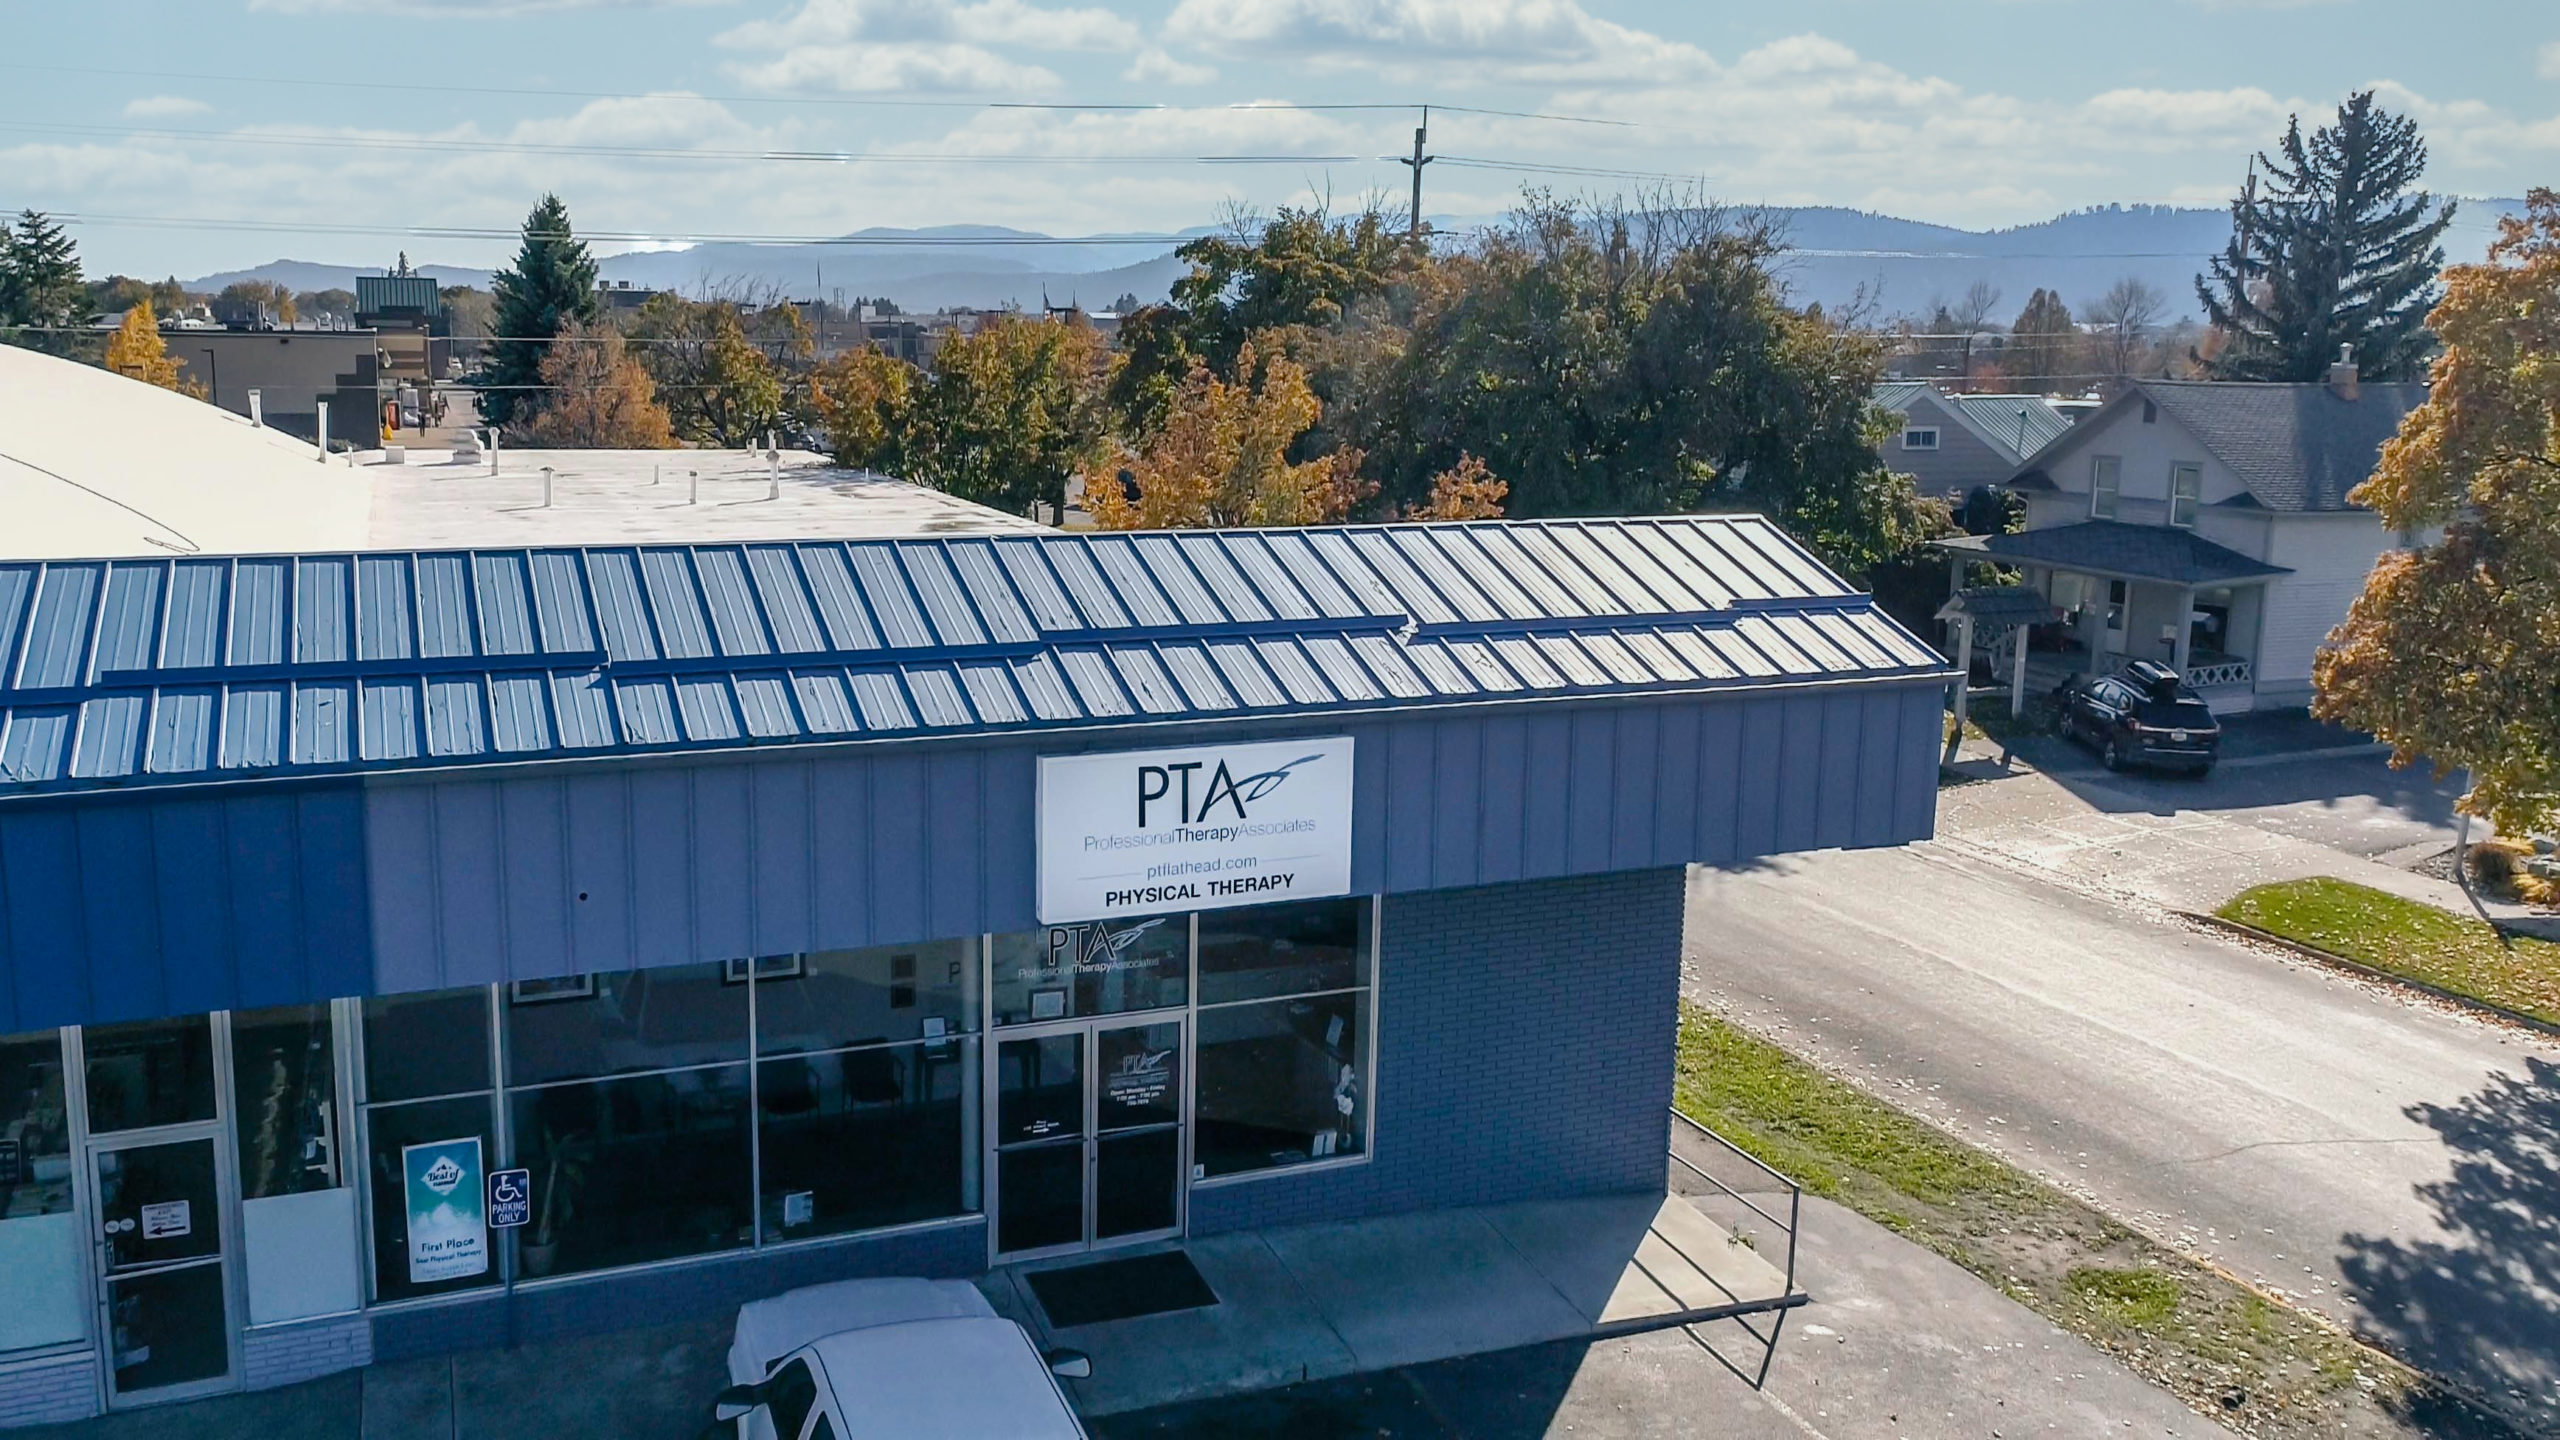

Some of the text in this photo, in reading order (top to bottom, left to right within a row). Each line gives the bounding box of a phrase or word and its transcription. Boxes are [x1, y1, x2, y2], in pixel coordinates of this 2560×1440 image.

[1138, 758, 1246, 828] PTA
[1147, 856, 1257, 881] ptflathead.com
[1105, 873, 1295, 907] PHYSICAL THERAPY
[1048, 921, 1117, 966] PTA
[493, 1201, 526, 1215] PARKING
[498, 1211, 520, 1223] ONLY
[421, 1238, 475, 1252] First Place
